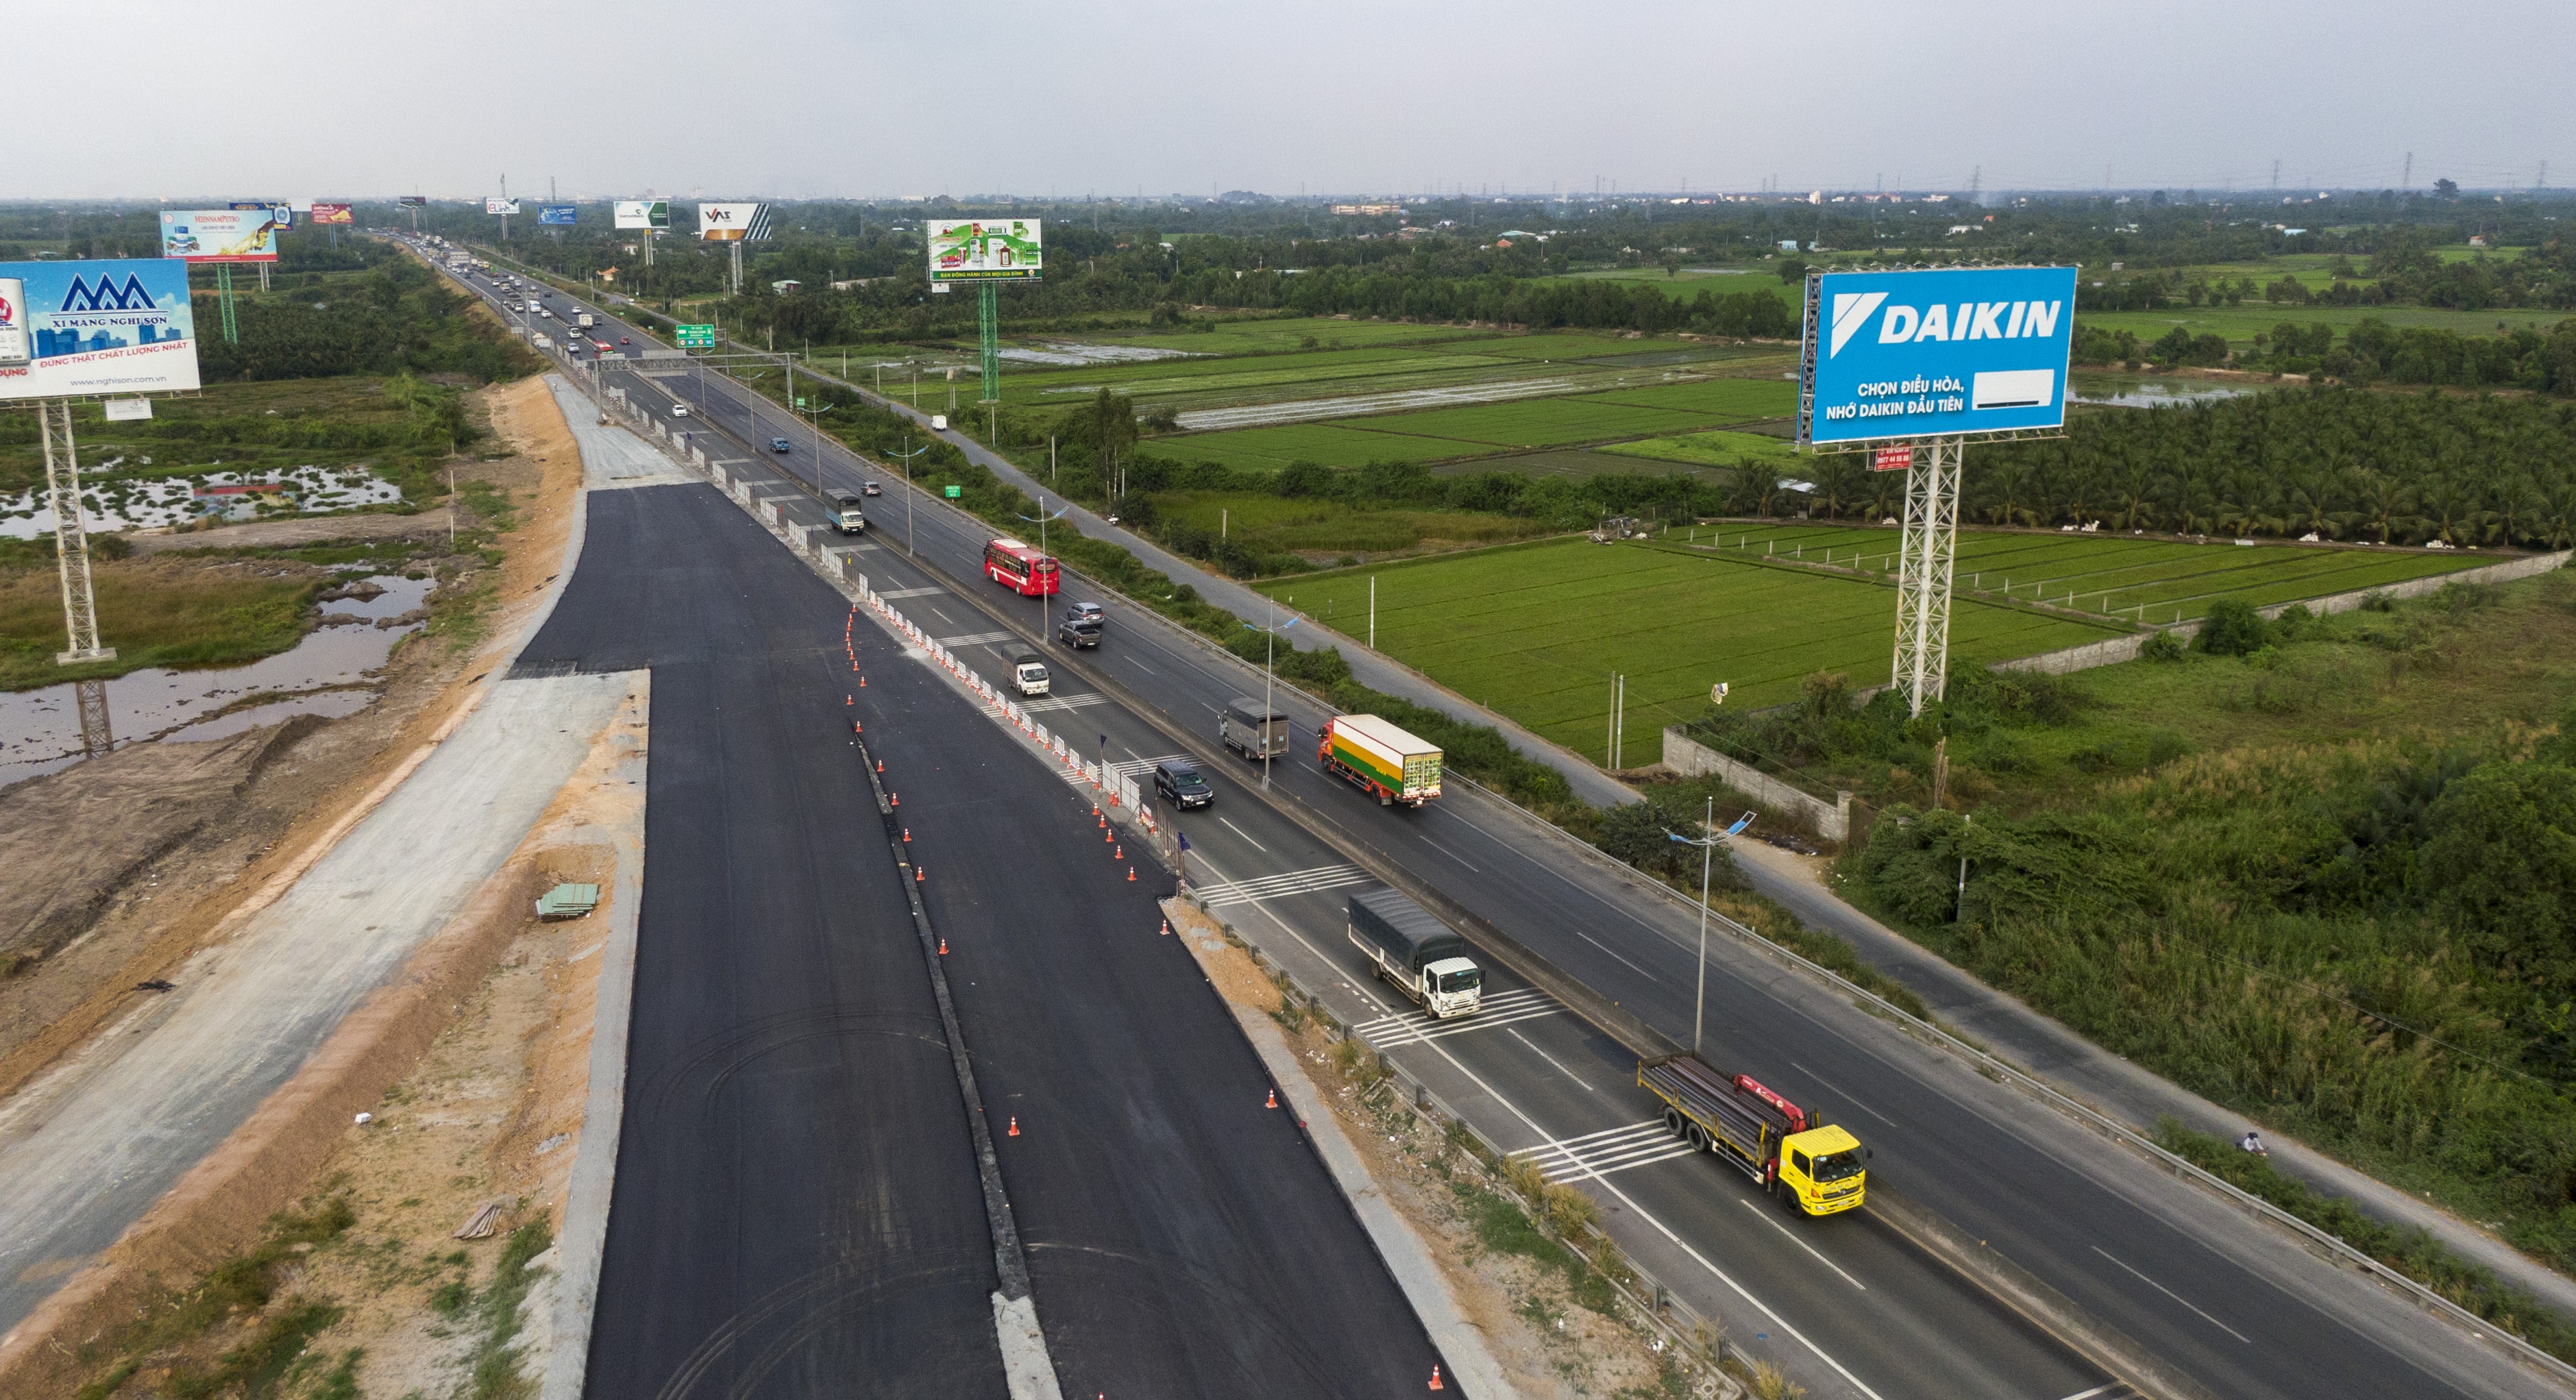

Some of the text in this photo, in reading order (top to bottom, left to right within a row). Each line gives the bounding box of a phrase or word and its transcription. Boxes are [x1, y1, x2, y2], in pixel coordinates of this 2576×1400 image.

[69, 317, 106, 327] MĂNG
[110, 317, 140, 326] NGHI
[144, 316, 167, 324] SƠN
[1878, 300, 2061, 344] DAIKIN
[40, 358, 69, 368] ĐÚNG
[71, 354, 96, 364] THẬT
[99, 348, 125, 360] CHẤT
[127, 345, 160, 356] LƯỢNG
[70, 376, 167, 386] www.nghison.com.vn
[1858, 373, 1965, 400] CHỌN ĐIỀU HÒA,
[1826, 394, 1963, 419] NHỚ DAIKIN ĐẦU TIÊN
